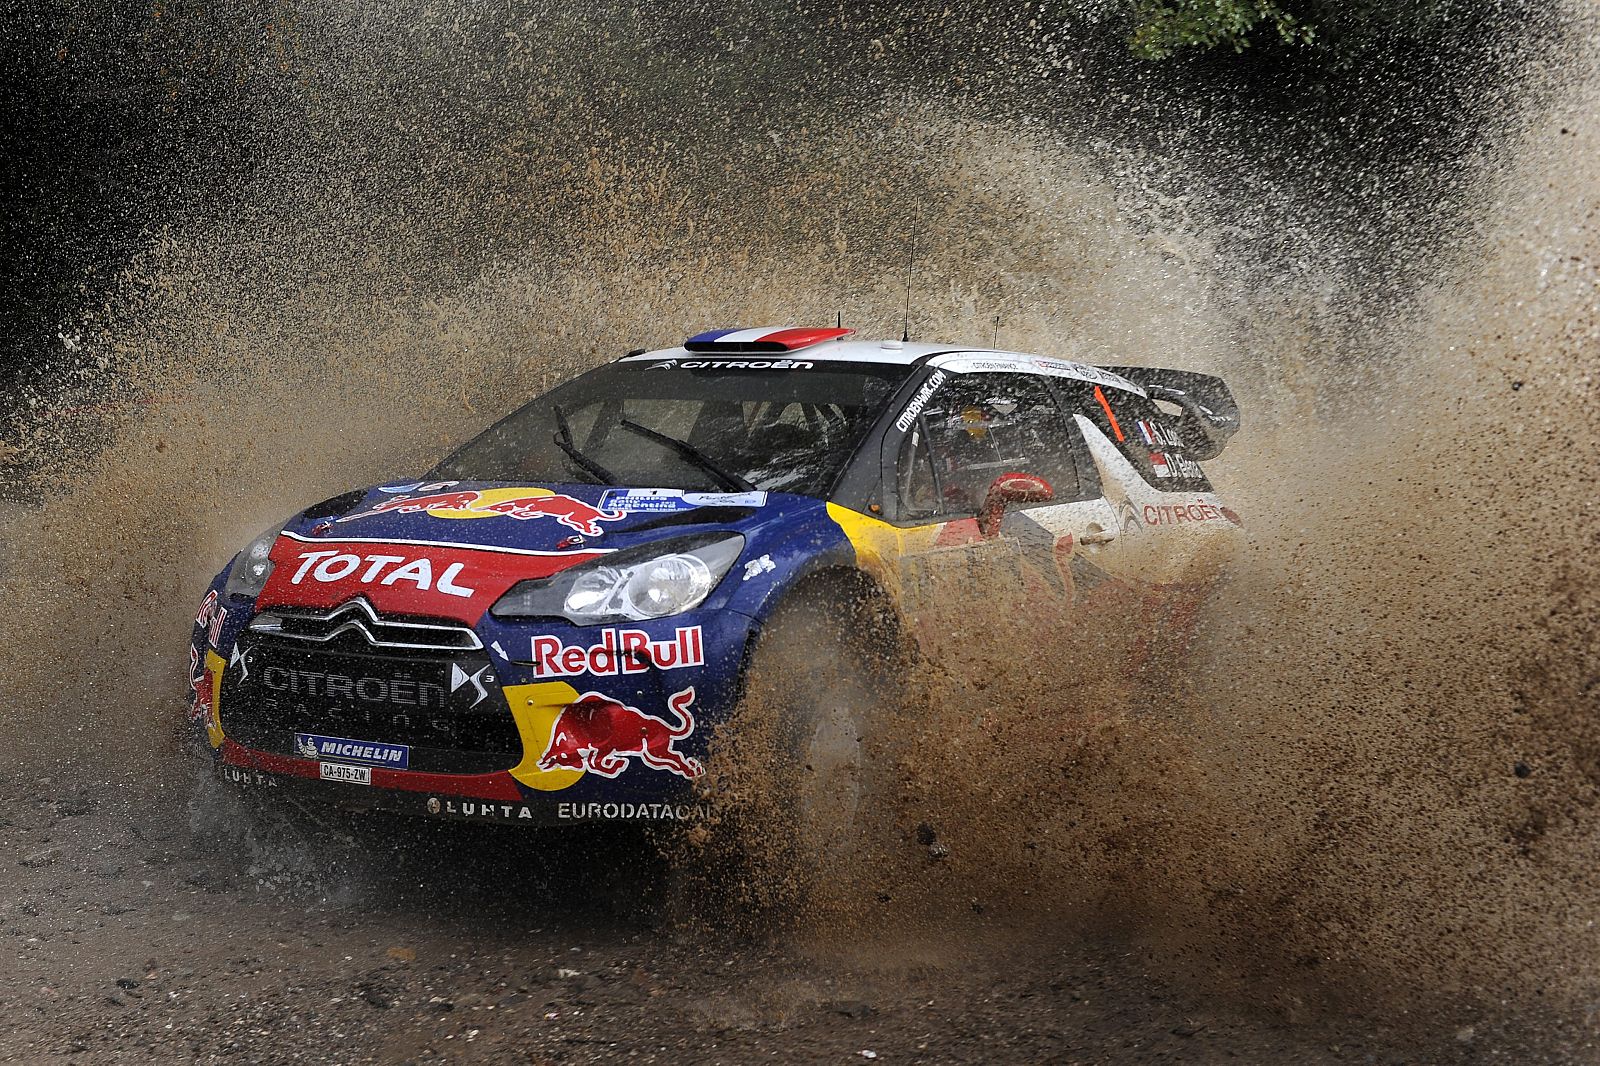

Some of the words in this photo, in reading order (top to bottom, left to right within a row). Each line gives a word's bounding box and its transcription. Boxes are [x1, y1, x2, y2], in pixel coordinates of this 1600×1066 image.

[291, 550, 475, 598] TOTAL
[531, 628, 617, 678] Red
[620, 625, 705, 674] Bull
[320, 741, 403, 762] MICHELIN
[323, 764, 367, 781] CA-975-ZW
[446, 800, 533, 819] LUHTA
